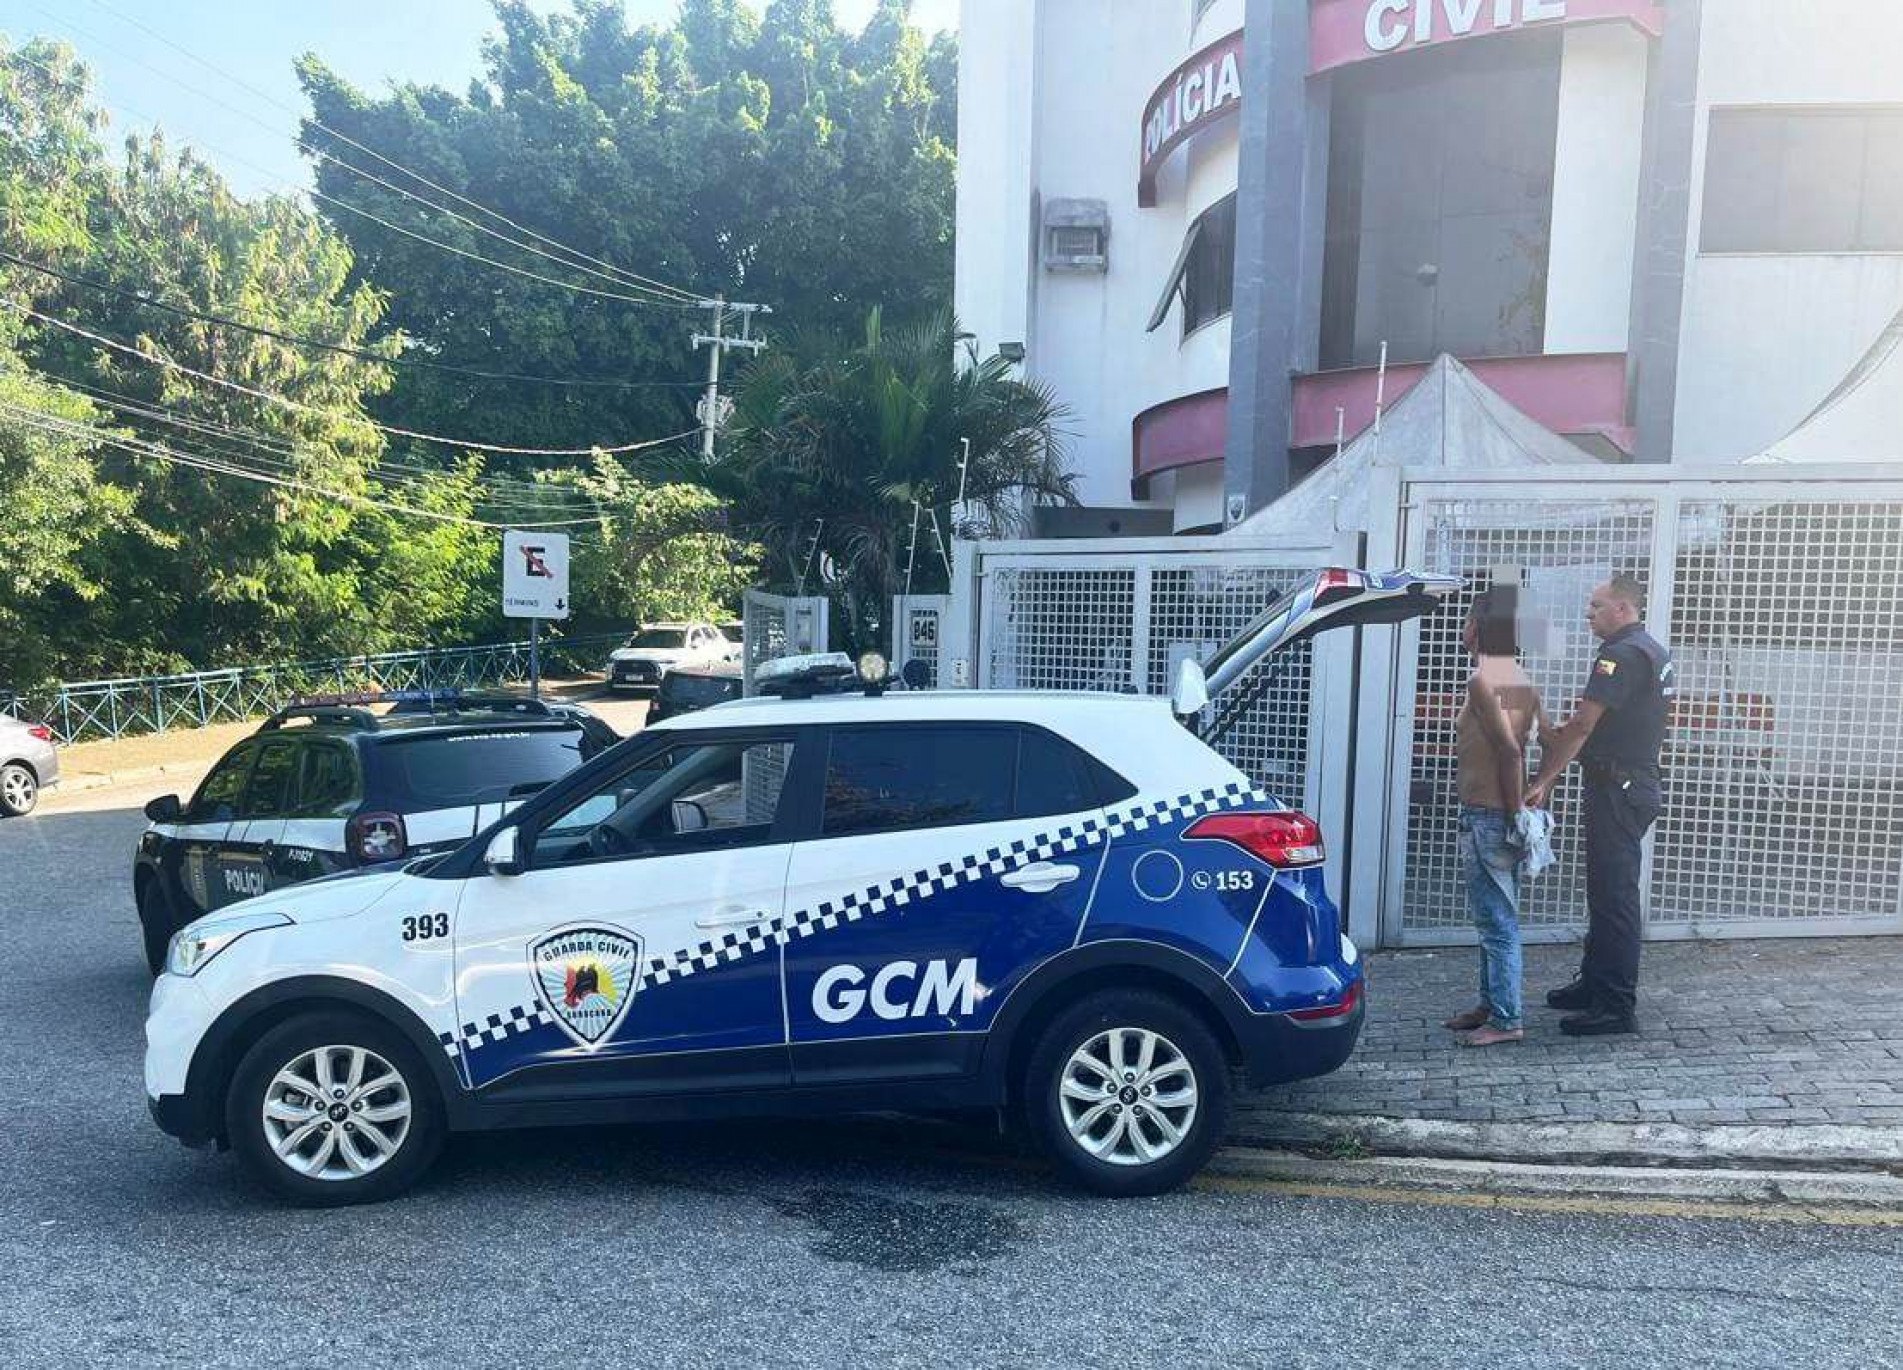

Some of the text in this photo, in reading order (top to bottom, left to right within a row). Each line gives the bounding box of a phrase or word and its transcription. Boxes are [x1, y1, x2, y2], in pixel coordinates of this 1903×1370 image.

[1144, 52, 1242, 165] POLÍCIA
[1216, 870, 1254, 891] 153
[401, 912, 449, 941] 393
[812, 956, 977, 1024] GCM
